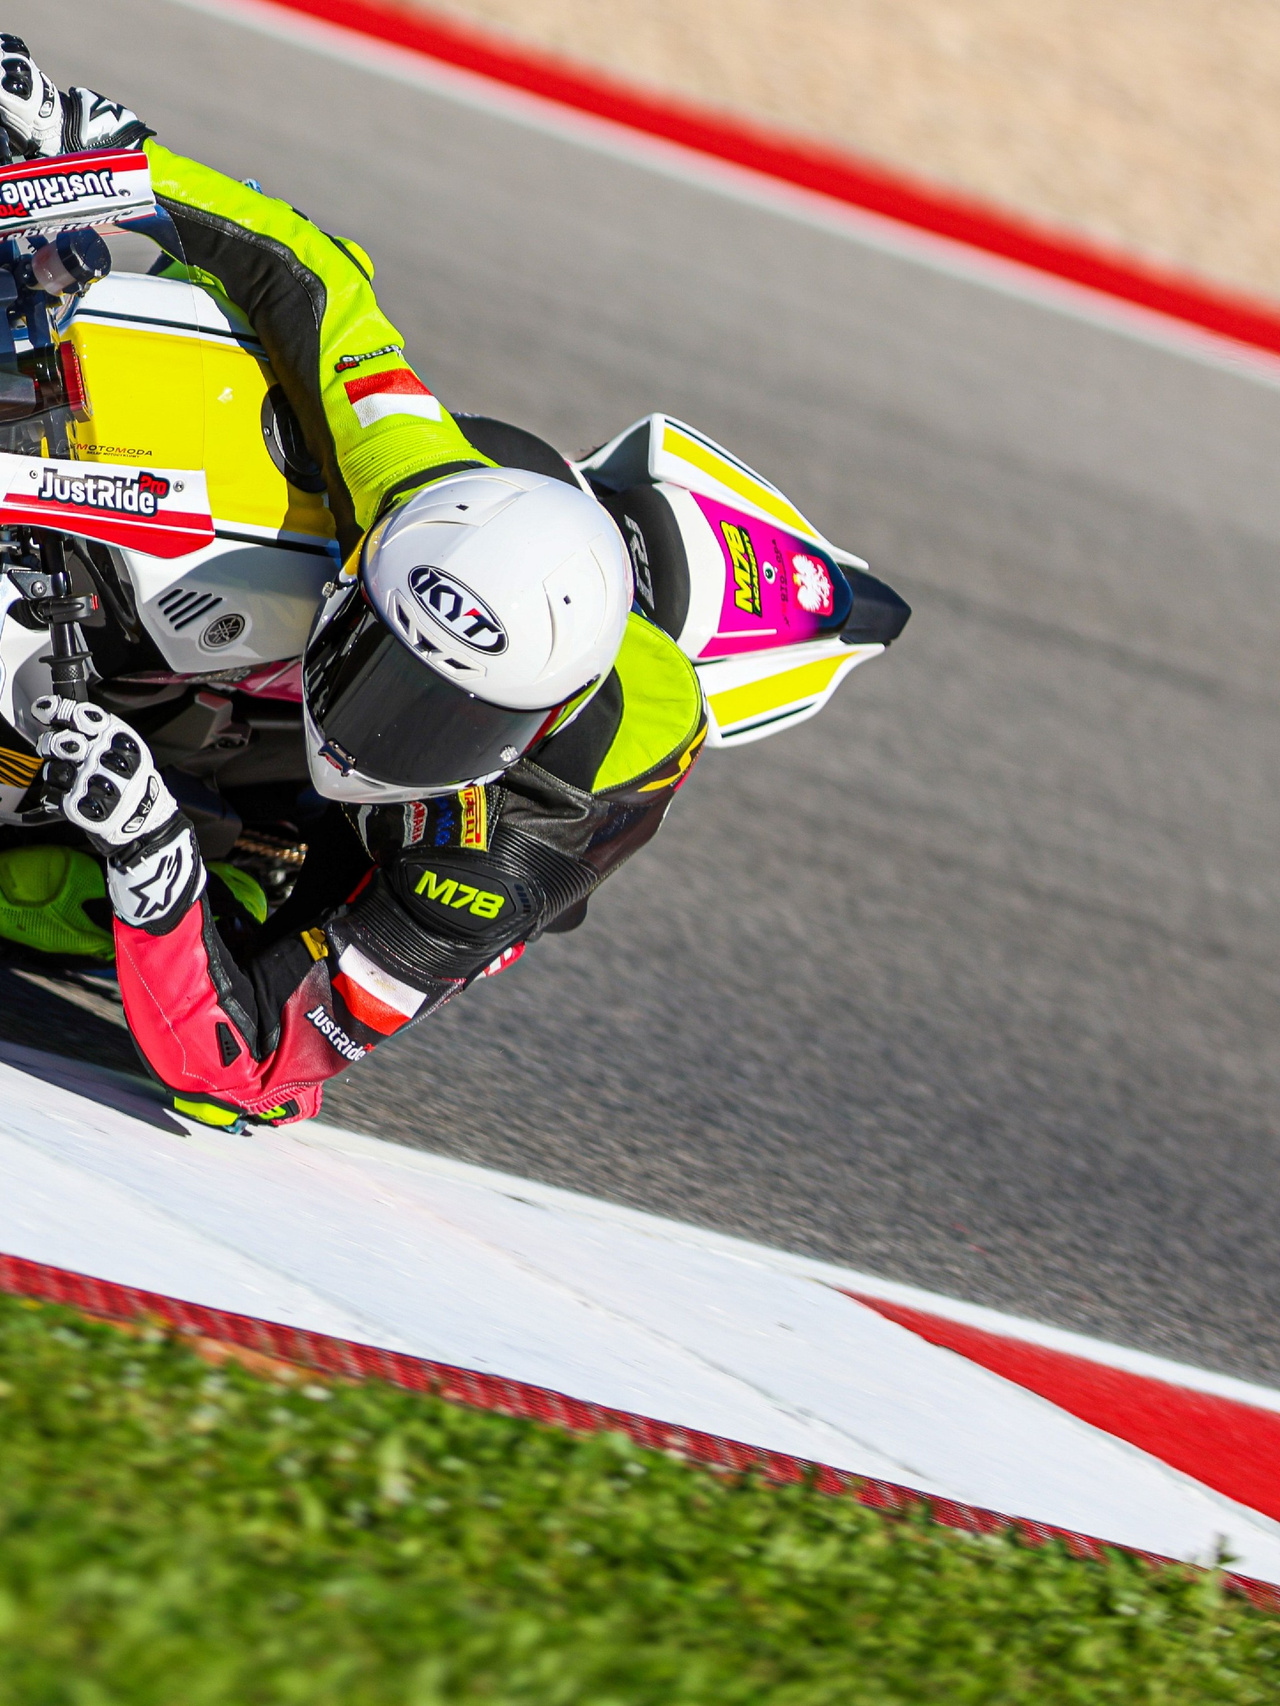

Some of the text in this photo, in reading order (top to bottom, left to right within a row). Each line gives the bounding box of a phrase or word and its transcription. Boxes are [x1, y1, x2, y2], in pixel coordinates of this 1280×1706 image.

[76, 443, 153, 456] MOTOMODA
[41, 470, 155, 515] JustRide
[720, 520, 753, 613] M78
[410, 567, 504, 640] KYT
[414, 869, 506, 920] M78
